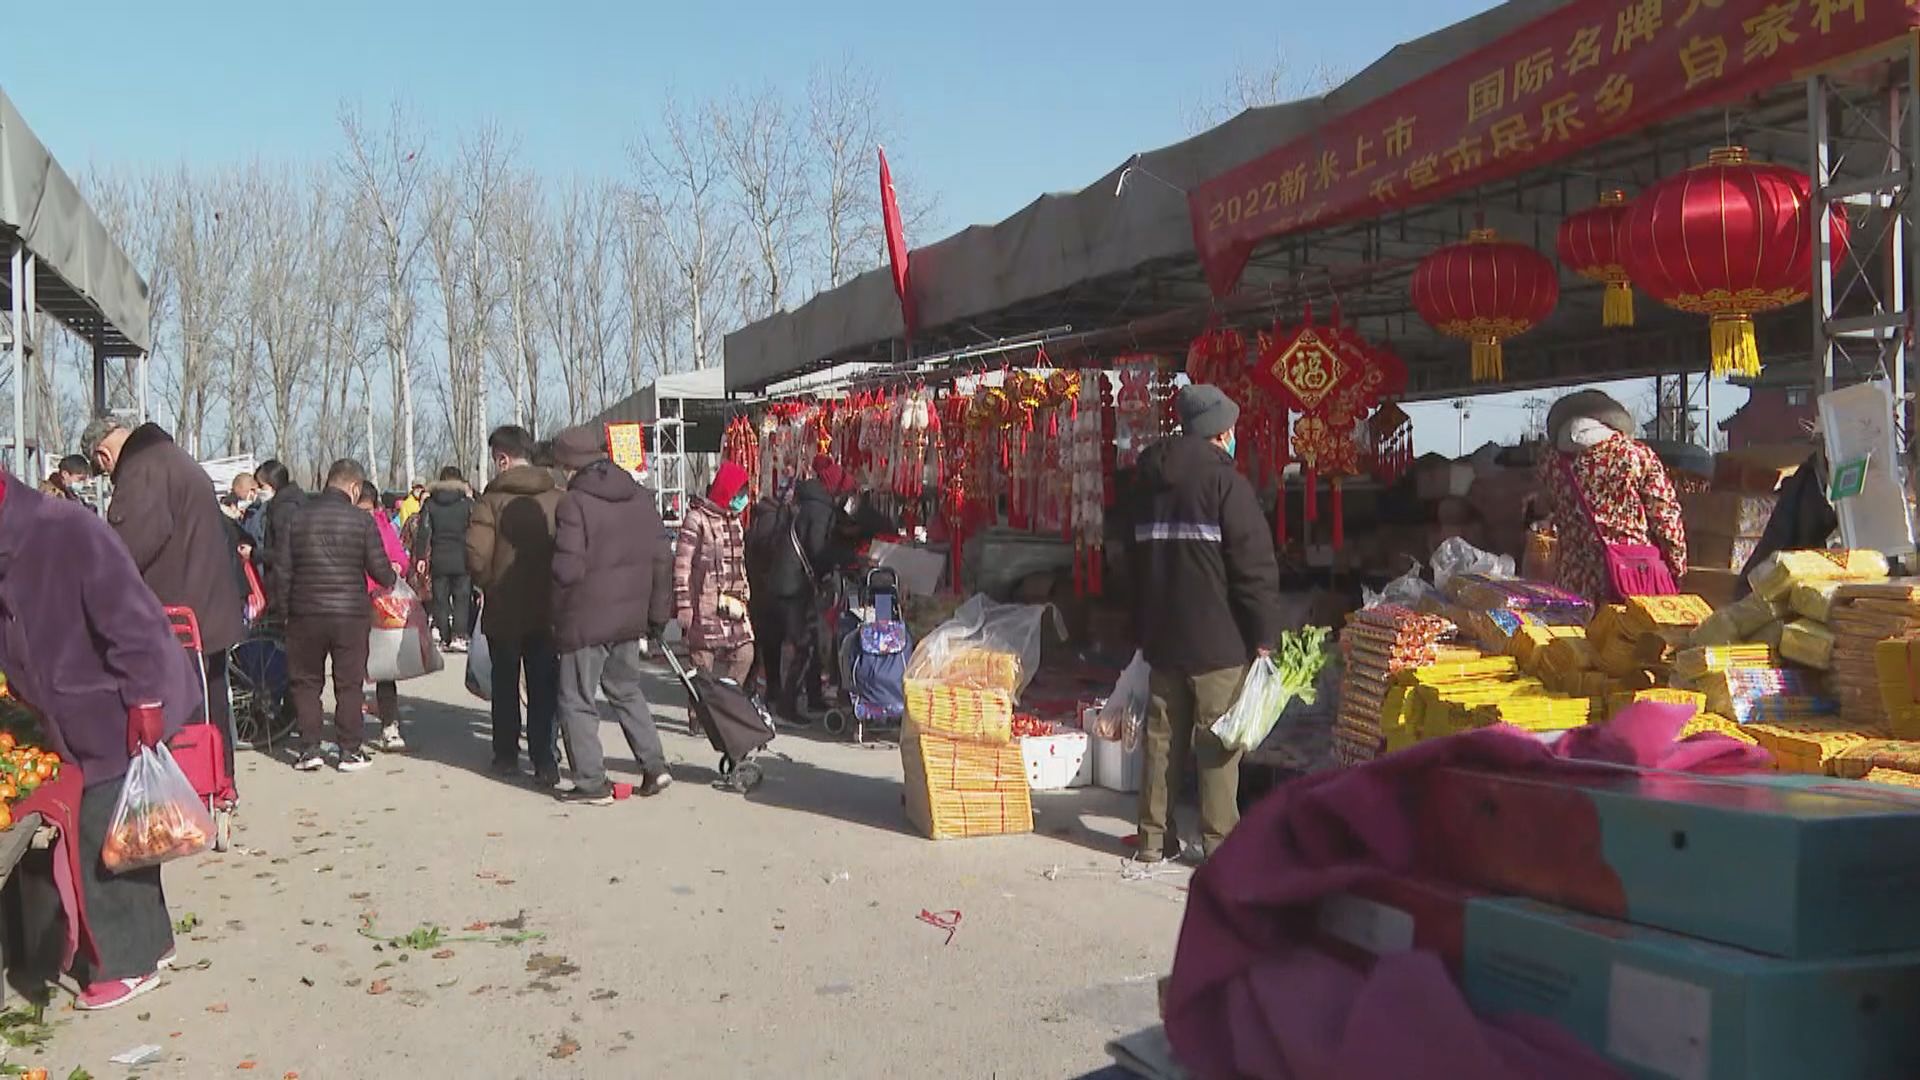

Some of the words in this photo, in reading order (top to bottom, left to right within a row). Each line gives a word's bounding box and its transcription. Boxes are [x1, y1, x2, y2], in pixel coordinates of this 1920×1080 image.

[1209, 115, 1416, 231] 2022新米上市
[1290, 350, 1328, 389] 福
